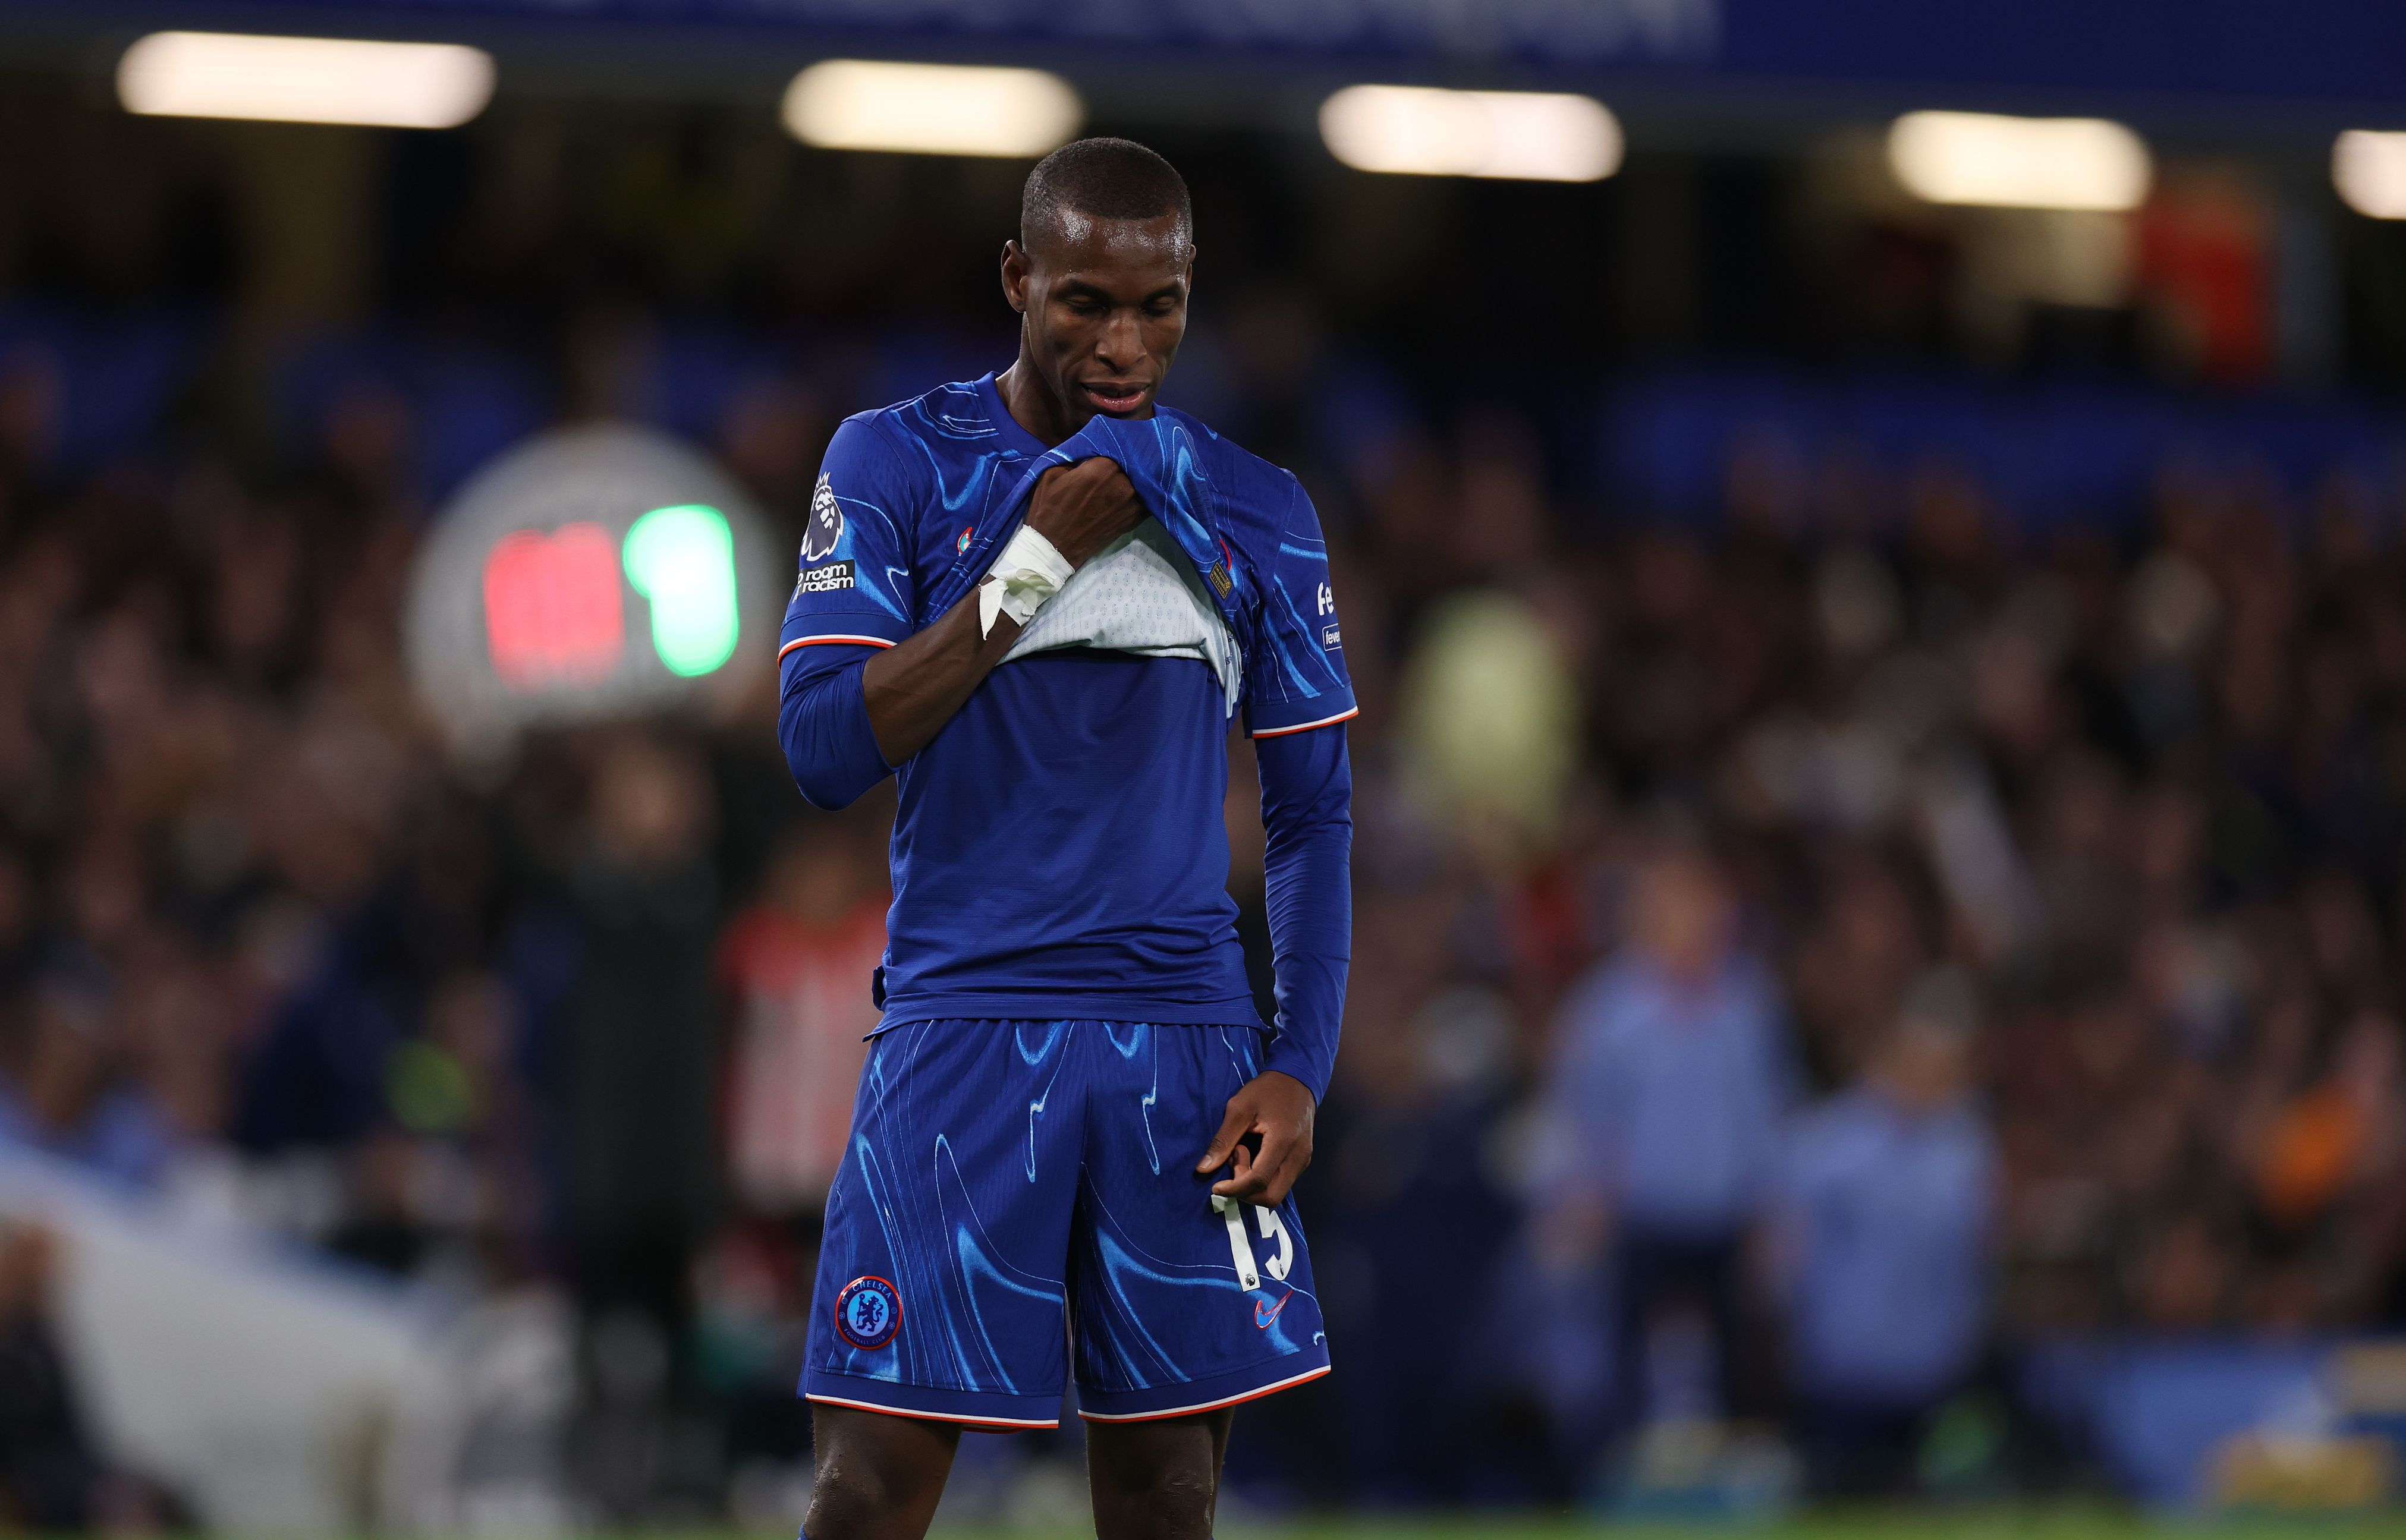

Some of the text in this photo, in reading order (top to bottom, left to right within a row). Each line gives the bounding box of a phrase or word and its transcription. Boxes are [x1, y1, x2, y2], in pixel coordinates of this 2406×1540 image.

[806, 564, 847, 581] room
[802, 576, 854, 593] racism
[1211, 1194, 1293, 1292] 15
[853, 1280, 892, 1299] CHELSEA
